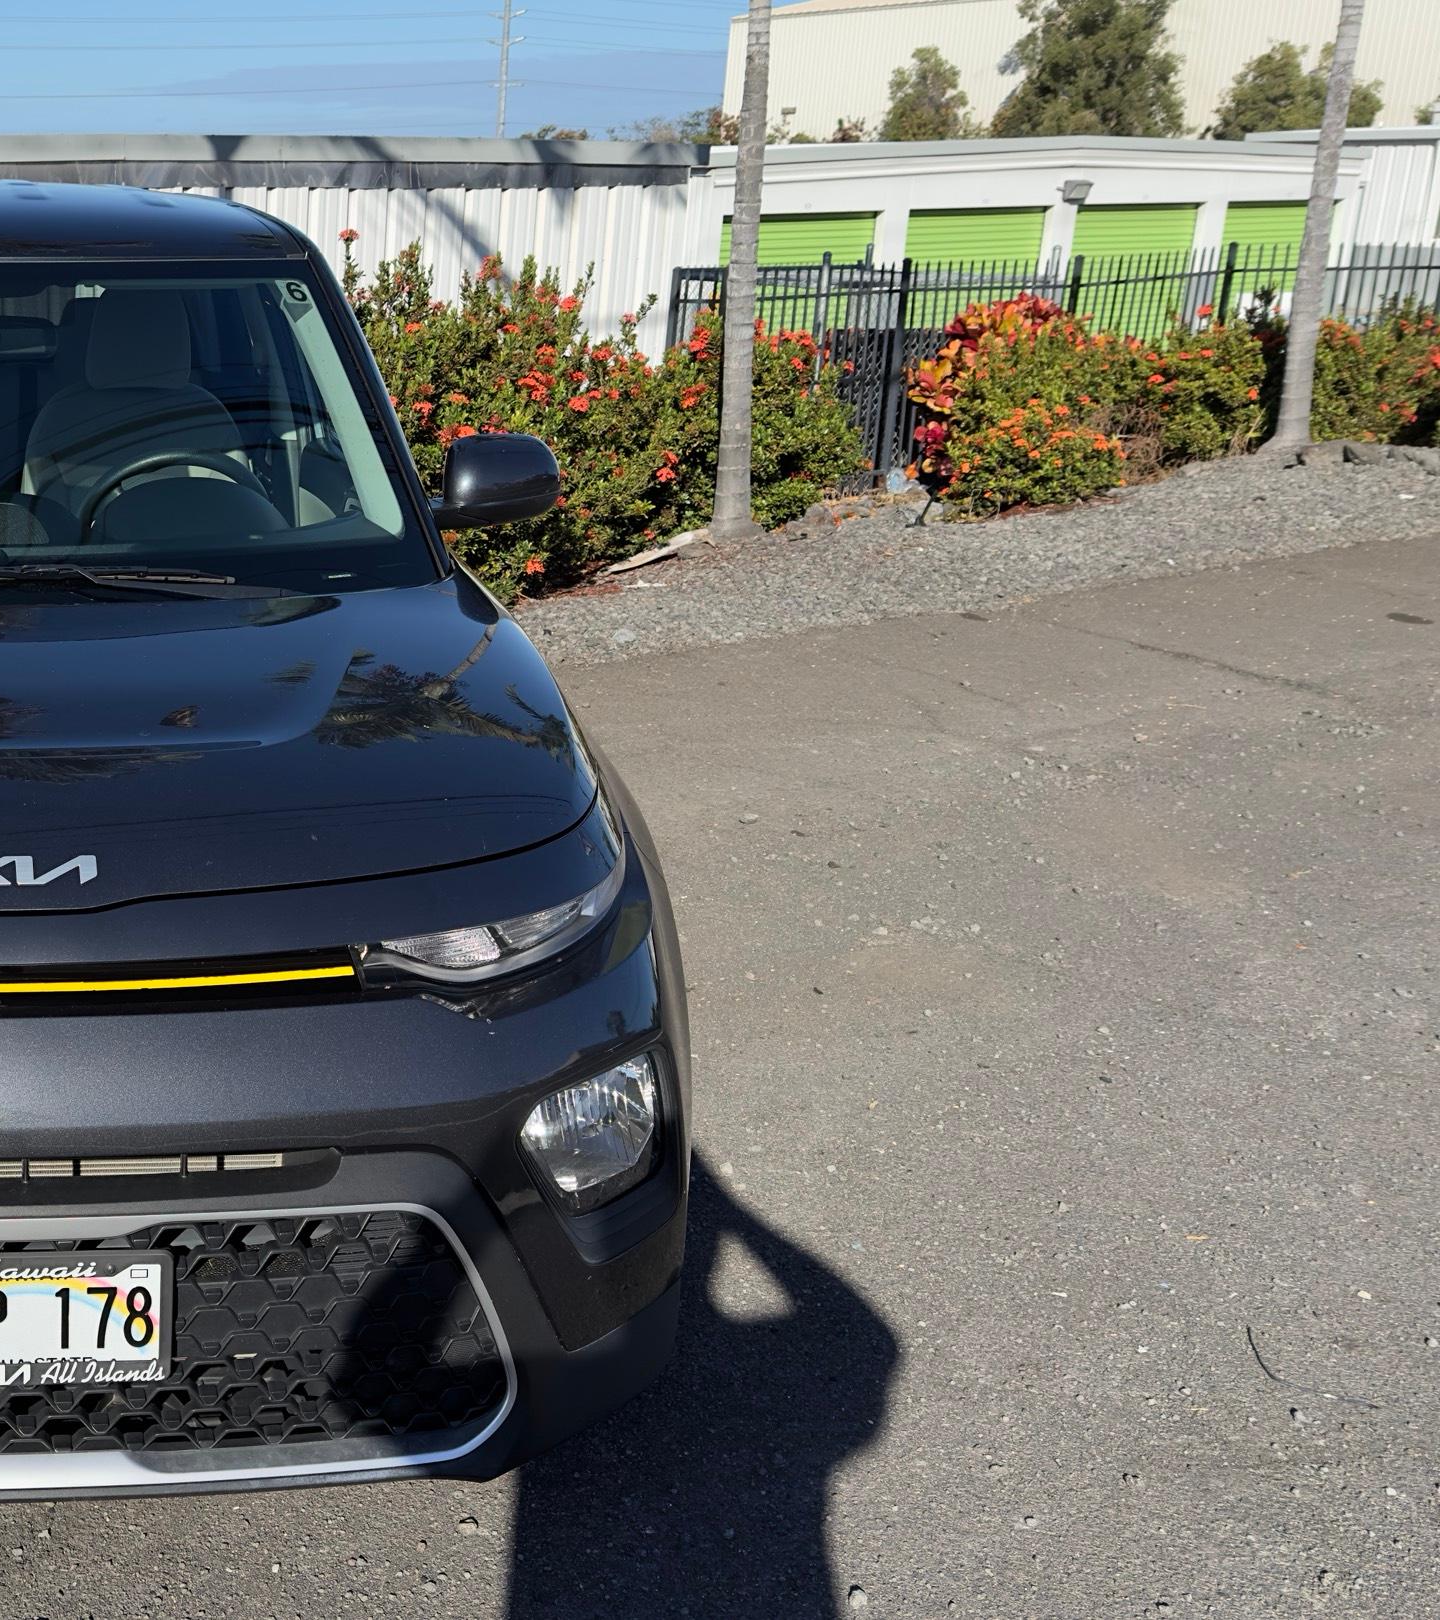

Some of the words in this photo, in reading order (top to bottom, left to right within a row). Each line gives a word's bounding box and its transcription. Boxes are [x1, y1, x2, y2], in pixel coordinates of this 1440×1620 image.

[286, 282, 307, 302] 6
[55, 1286, 154, 1349] 178
[40, 1361, 78, 1385] All
[80, 1360, 165, 1384] Islands
